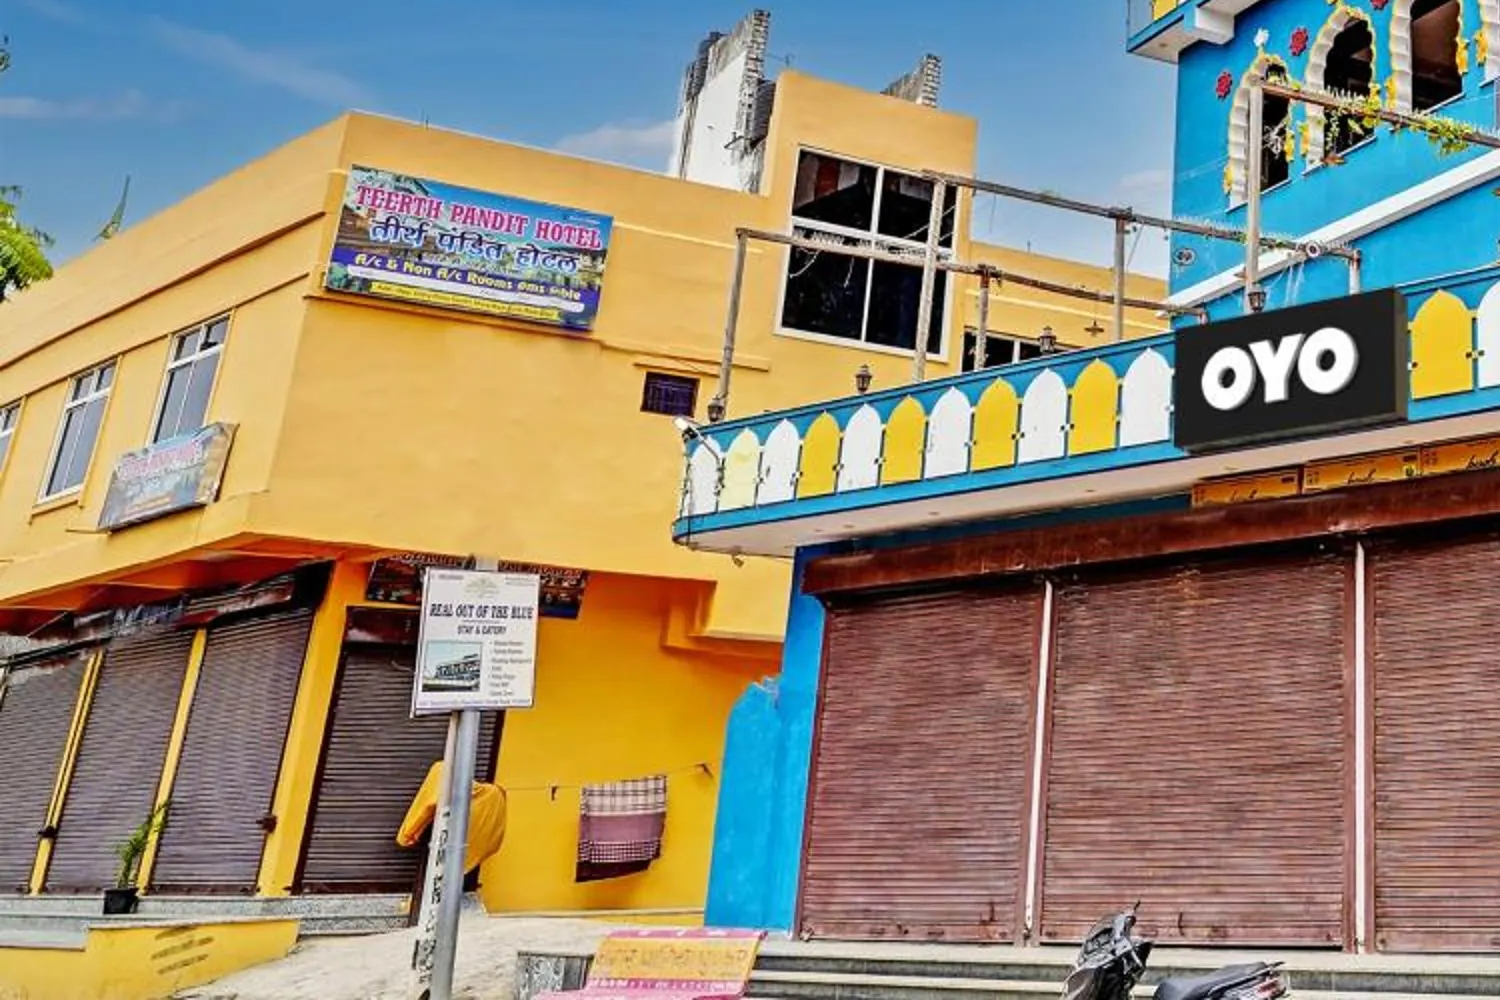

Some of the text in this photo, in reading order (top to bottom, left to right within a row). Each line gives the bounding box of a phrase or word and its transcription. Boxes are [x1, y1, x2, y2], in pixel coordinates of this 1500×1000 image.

[356, 185, 603, 250] TEERTH PANDIT HOTEL
[369, 215, 580, 273] तीर्थ पंडित होटल
[402, 259, 433, 277] Non
[1201, 326, 1359, 412] OYO
[430, 603, 534, 620] REAL OUT OF THE BLUE
